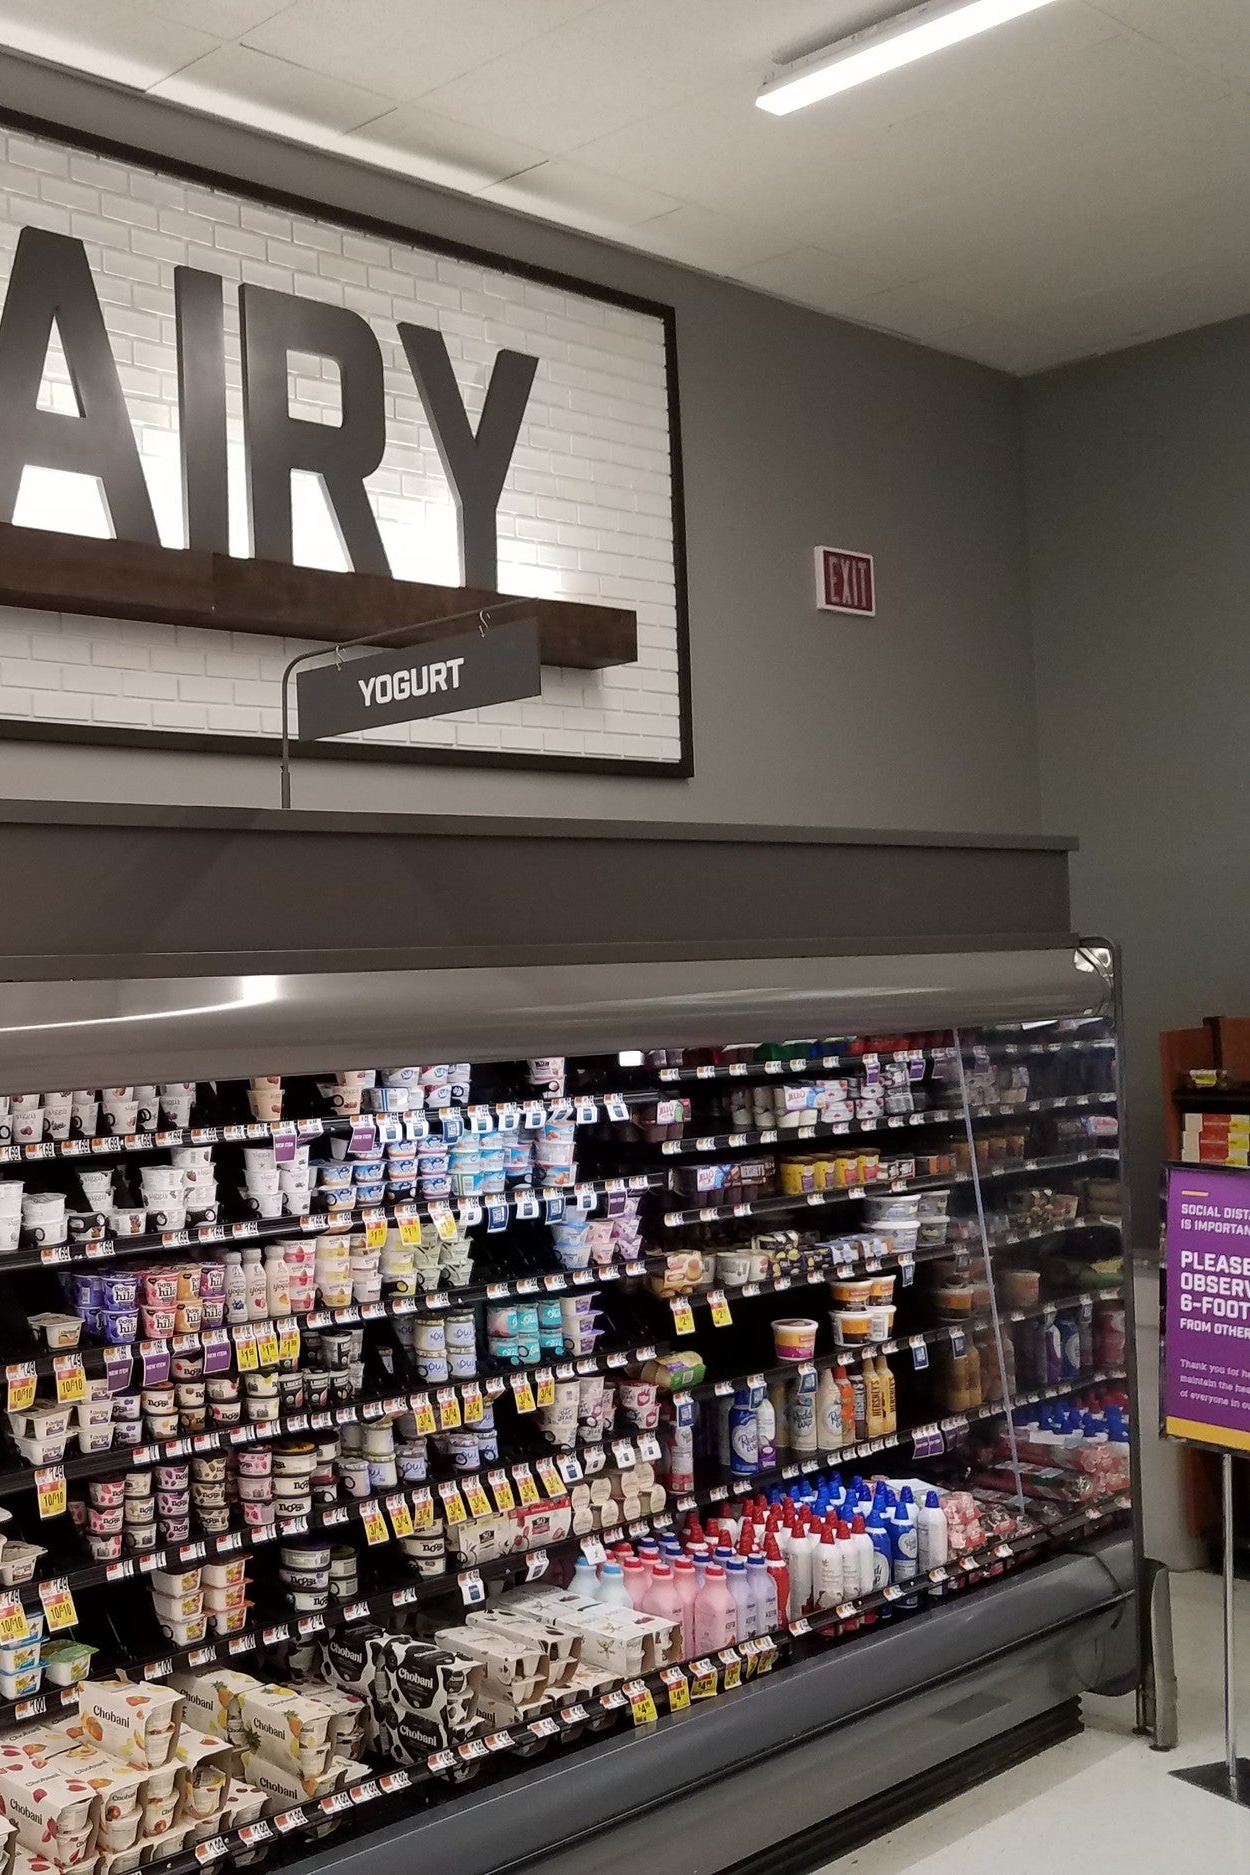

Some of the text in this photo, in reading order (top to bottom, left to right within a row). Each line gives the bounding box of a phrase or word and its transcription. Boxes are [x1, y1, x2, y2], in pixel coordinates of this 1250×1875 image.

[829, 556, 867, 608] EXIT
[358, 657, 464, 706] YOGURT
[1181, 1203, 1221, 1217] SOCIAL
[1181, 1218, 1191, 1230] IS
[1180, 1293, 1250, 1320] 6-FOOT
[1180, 1318, 1212, 1334] FROM
[1180, 1358, 1207, 1371] Thank
[1209, 1363, 1225, 1375] you
[1227, 1365, 1239, 1376] for
[1190, 1393, 1229, 1407] everyone
[330, 1642, 362, 1664] Chobani
[399, 1668, 433, 1689] Chobani
[180, 1689, 214, 1711] Chobani
[93, 1706, 130, 1728] Chobani
[254, 1718, 286, 1740] Chobani
[400, 1726, 437, 1747] Chobani
[75, 1760, 108, 1775] Chobani
[26, 1773, 60, 1787] Chobani
[260, 1777, 297, 1799] Chobani
[10, 1799, 42, 1826] Chobani
